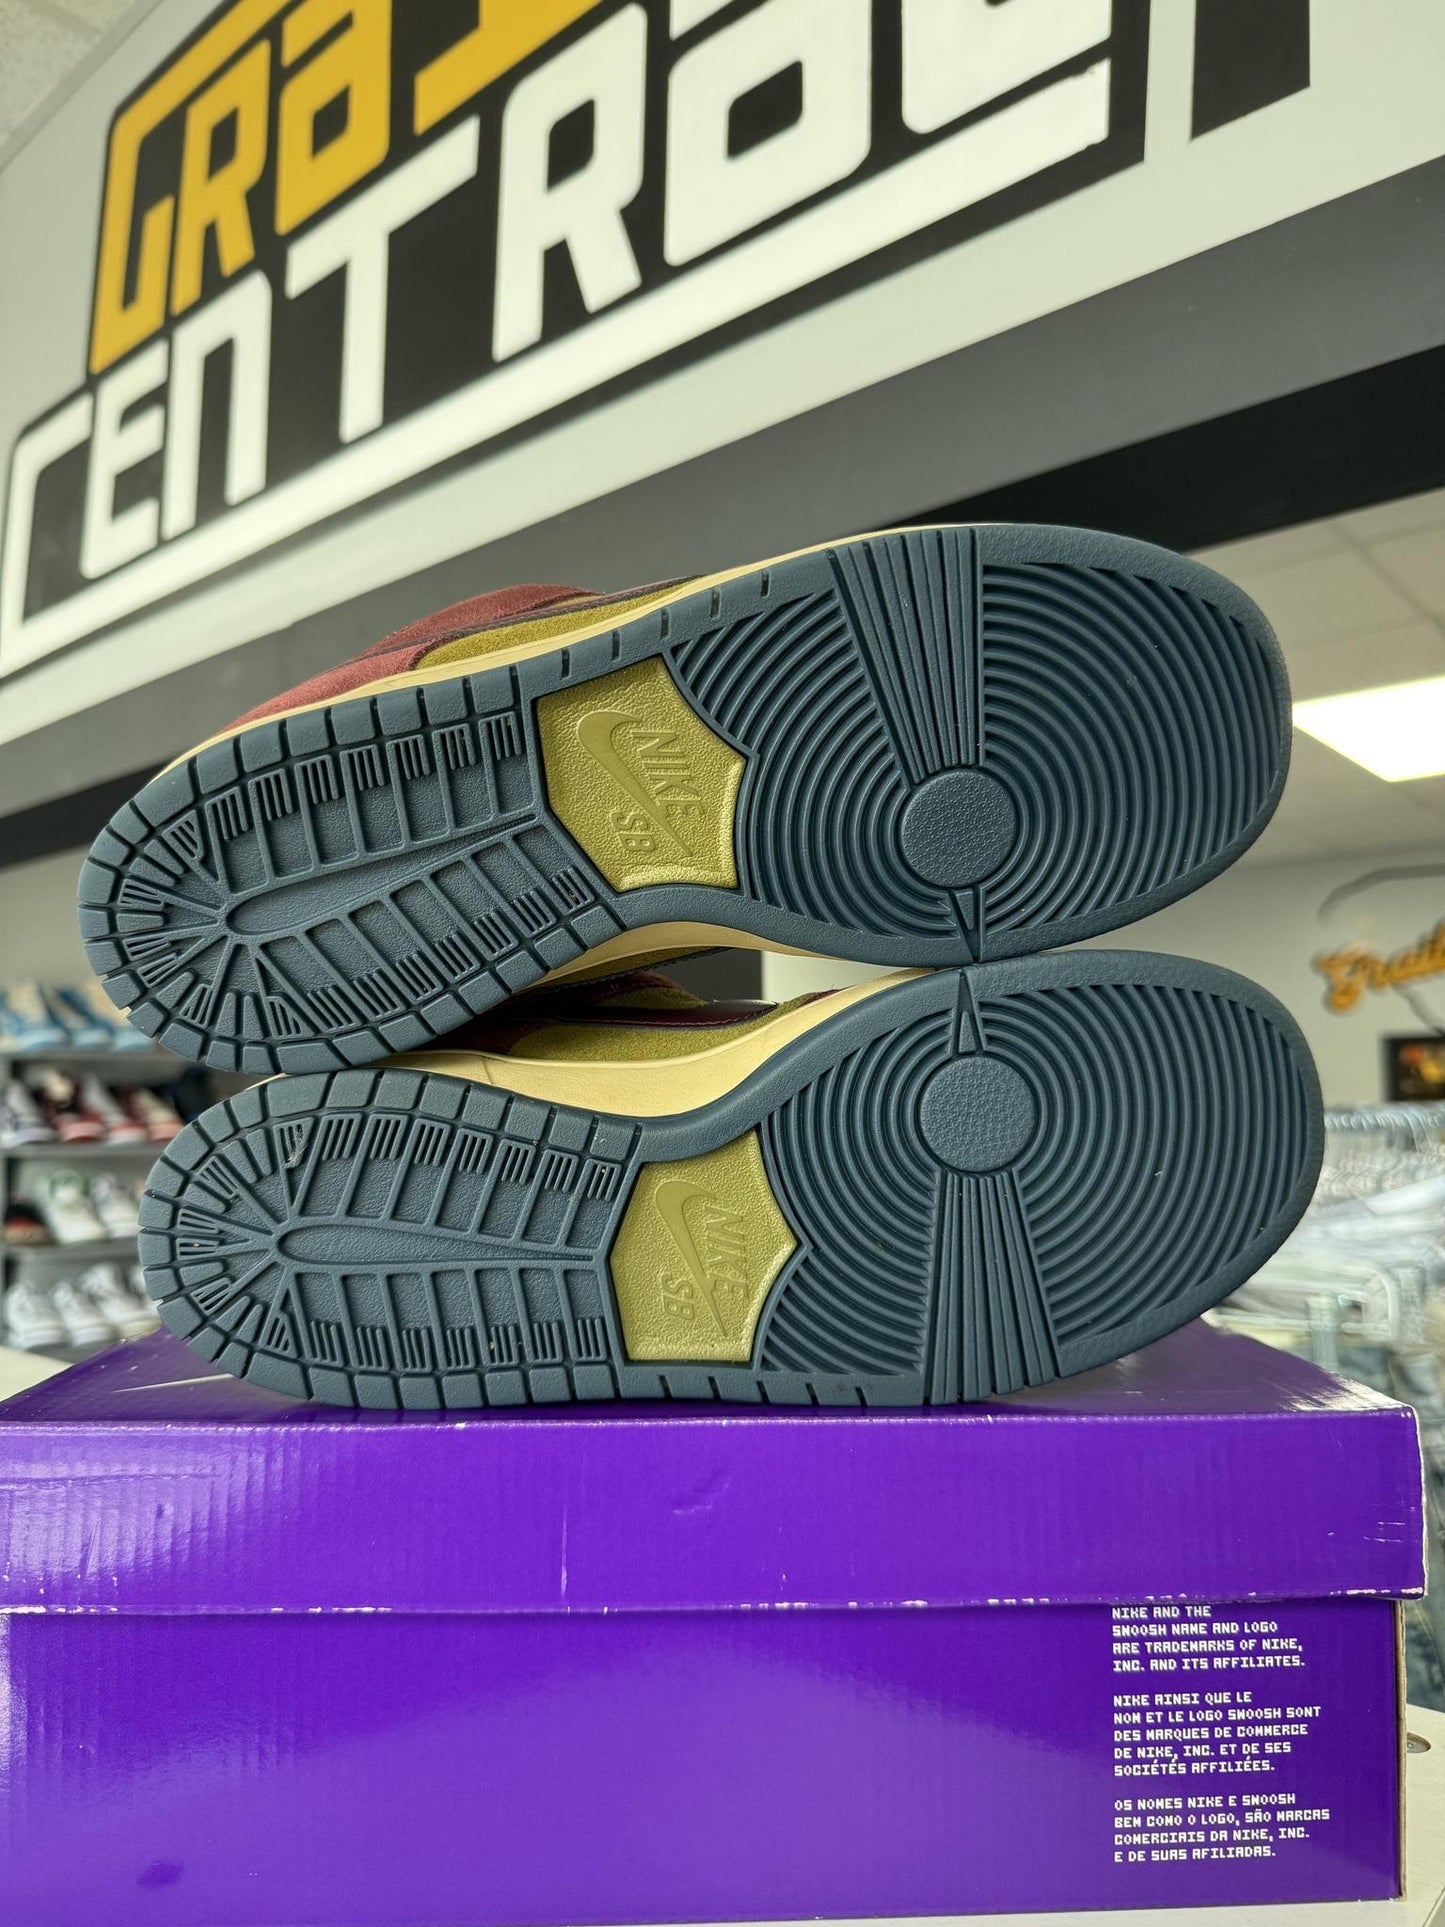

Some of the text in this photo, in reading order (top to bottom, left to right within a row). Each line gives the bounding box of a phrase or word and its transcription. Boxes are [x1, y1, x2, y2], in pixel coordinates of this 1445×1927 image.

[631, 729, 706, 817] NIKE
[610, 811, 656, 852] SB
[703, 1204, 751, 1300] NIKE
[661, 1272, 695, 1320] SB
[1113, 1606, 1211, 1619] NIKE AND THE
[1113, 1622, 1277, 1636] SWOOSH NAME AND LOGO
[1113, 1638, 1302, 1654] ARE TRADEMARKS OF NIKE,
[1113, 1656, 1304, 1672] INC. AND ITS AFFILIATES.
[1114, 1692, 1251, 1706] NIKE AINSI QUE LE
[1114, 1706, 1321, 1724] NOM ET LE LOGO SWOOSH SONT
[1114, 1724, 1308, 1741] DES MARQUES DE COMMERCE
[1114, 1742, 1291, 1759] DE NIKE, INC. ET DE SES
[1115, 1755, 1274, 1776] SOCIÉTÉS AFFILIÉES.
[1115, 1793, 1295, 1811] OS NOMES NIKE E SWOOSH
[1115, 1808, 1329, 1828] BEM COMO O LOGO, SÃO MARCAS
[1115, 1827, 1309, 1845] COMERCIAIS DA NIKE, INC.
[1115, 1846, 1275, 1862] E DE SUAS AFILIADAS.
